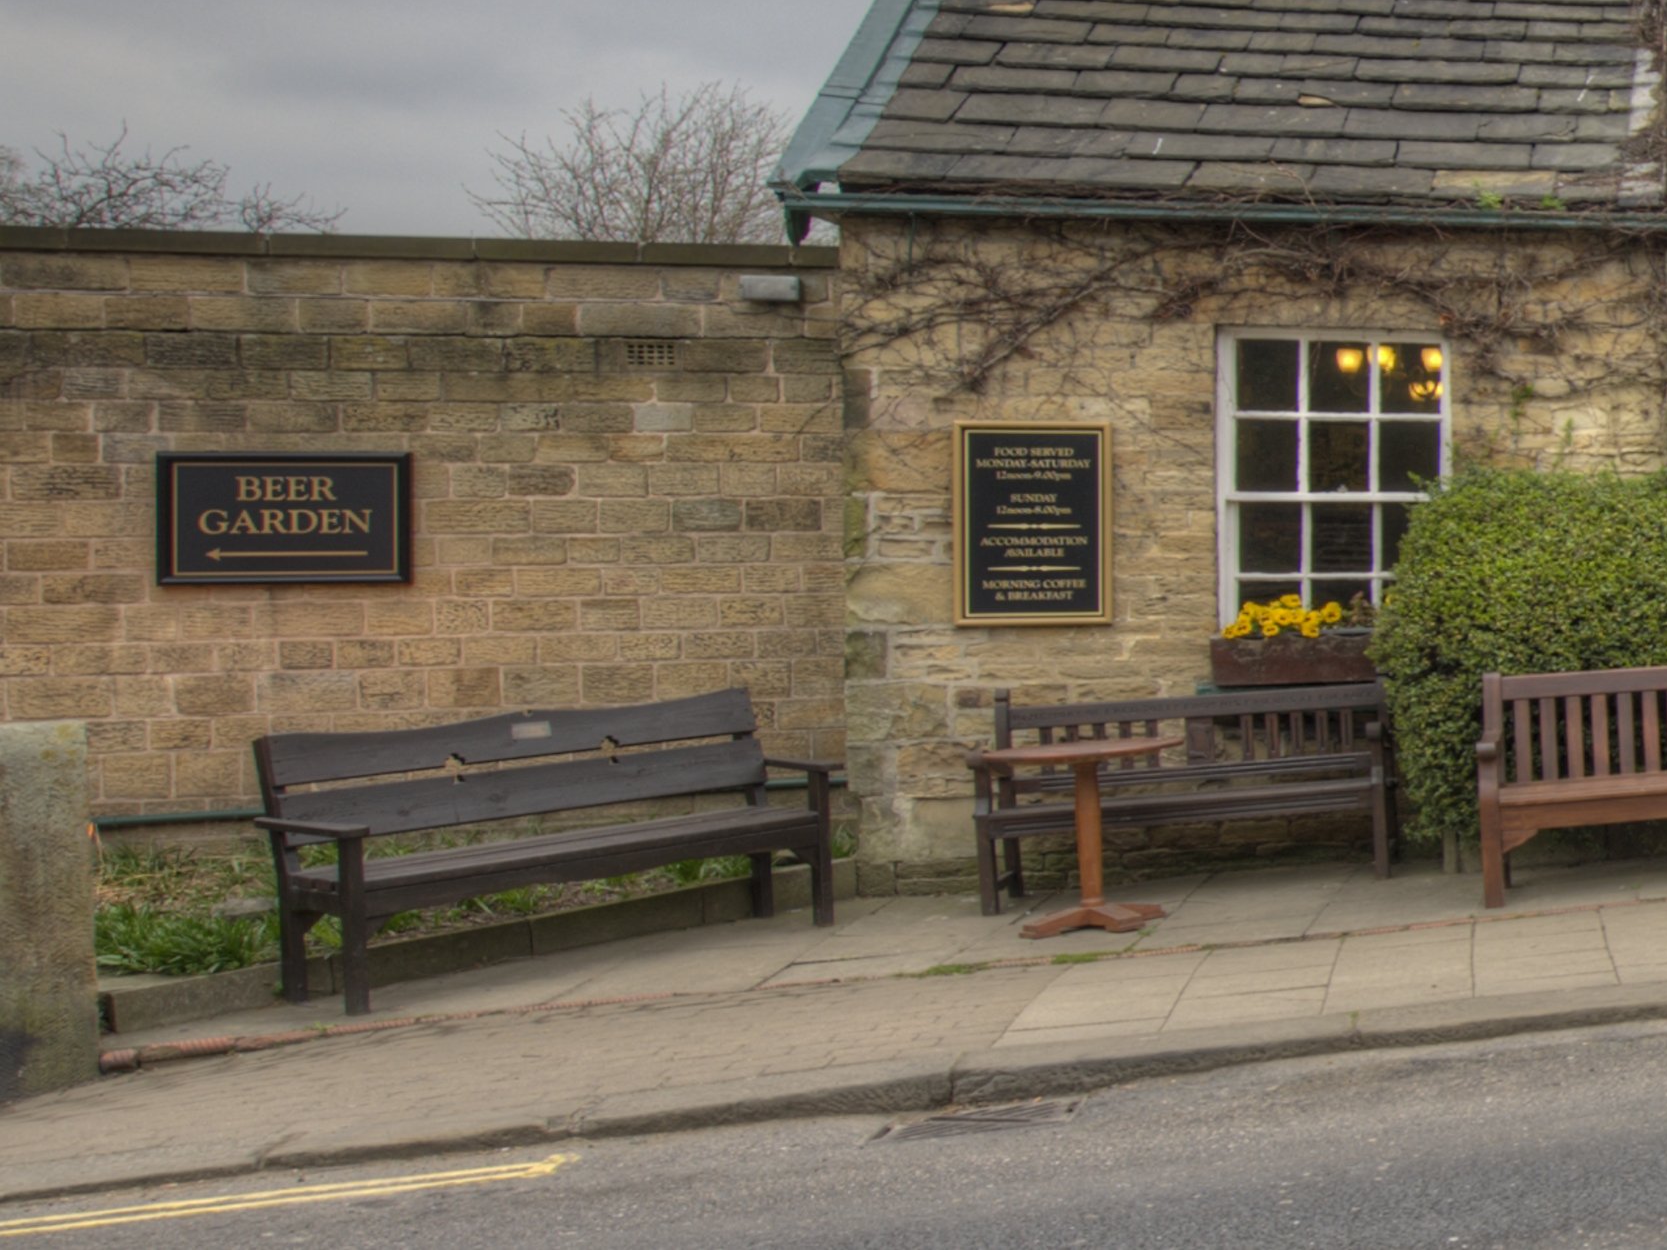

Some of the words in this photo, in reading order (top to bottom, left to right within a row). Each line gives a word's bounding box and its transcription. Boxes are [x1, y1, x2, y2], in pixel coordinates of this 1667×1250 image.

[994, 447, 1028, 456] FOOD
[1030, 447, 1074, 457] SERVED
[235, 476, 337, 501] BEER
[1010, 493, 1058, 503] SUNDAY
[197, 508, 373, 535] GARDEN
[980, 536, 1088, 546] ACCOMMODATION
[1004, 548, 1065, 557] AVAILABLE
[982, 579, 1041, 589] MORNING
[1043, 579, 1087, 589] COFFEE
[994, 591, 1006, 601] &
[1007, 590, 1073, 601] BREAKFAST
